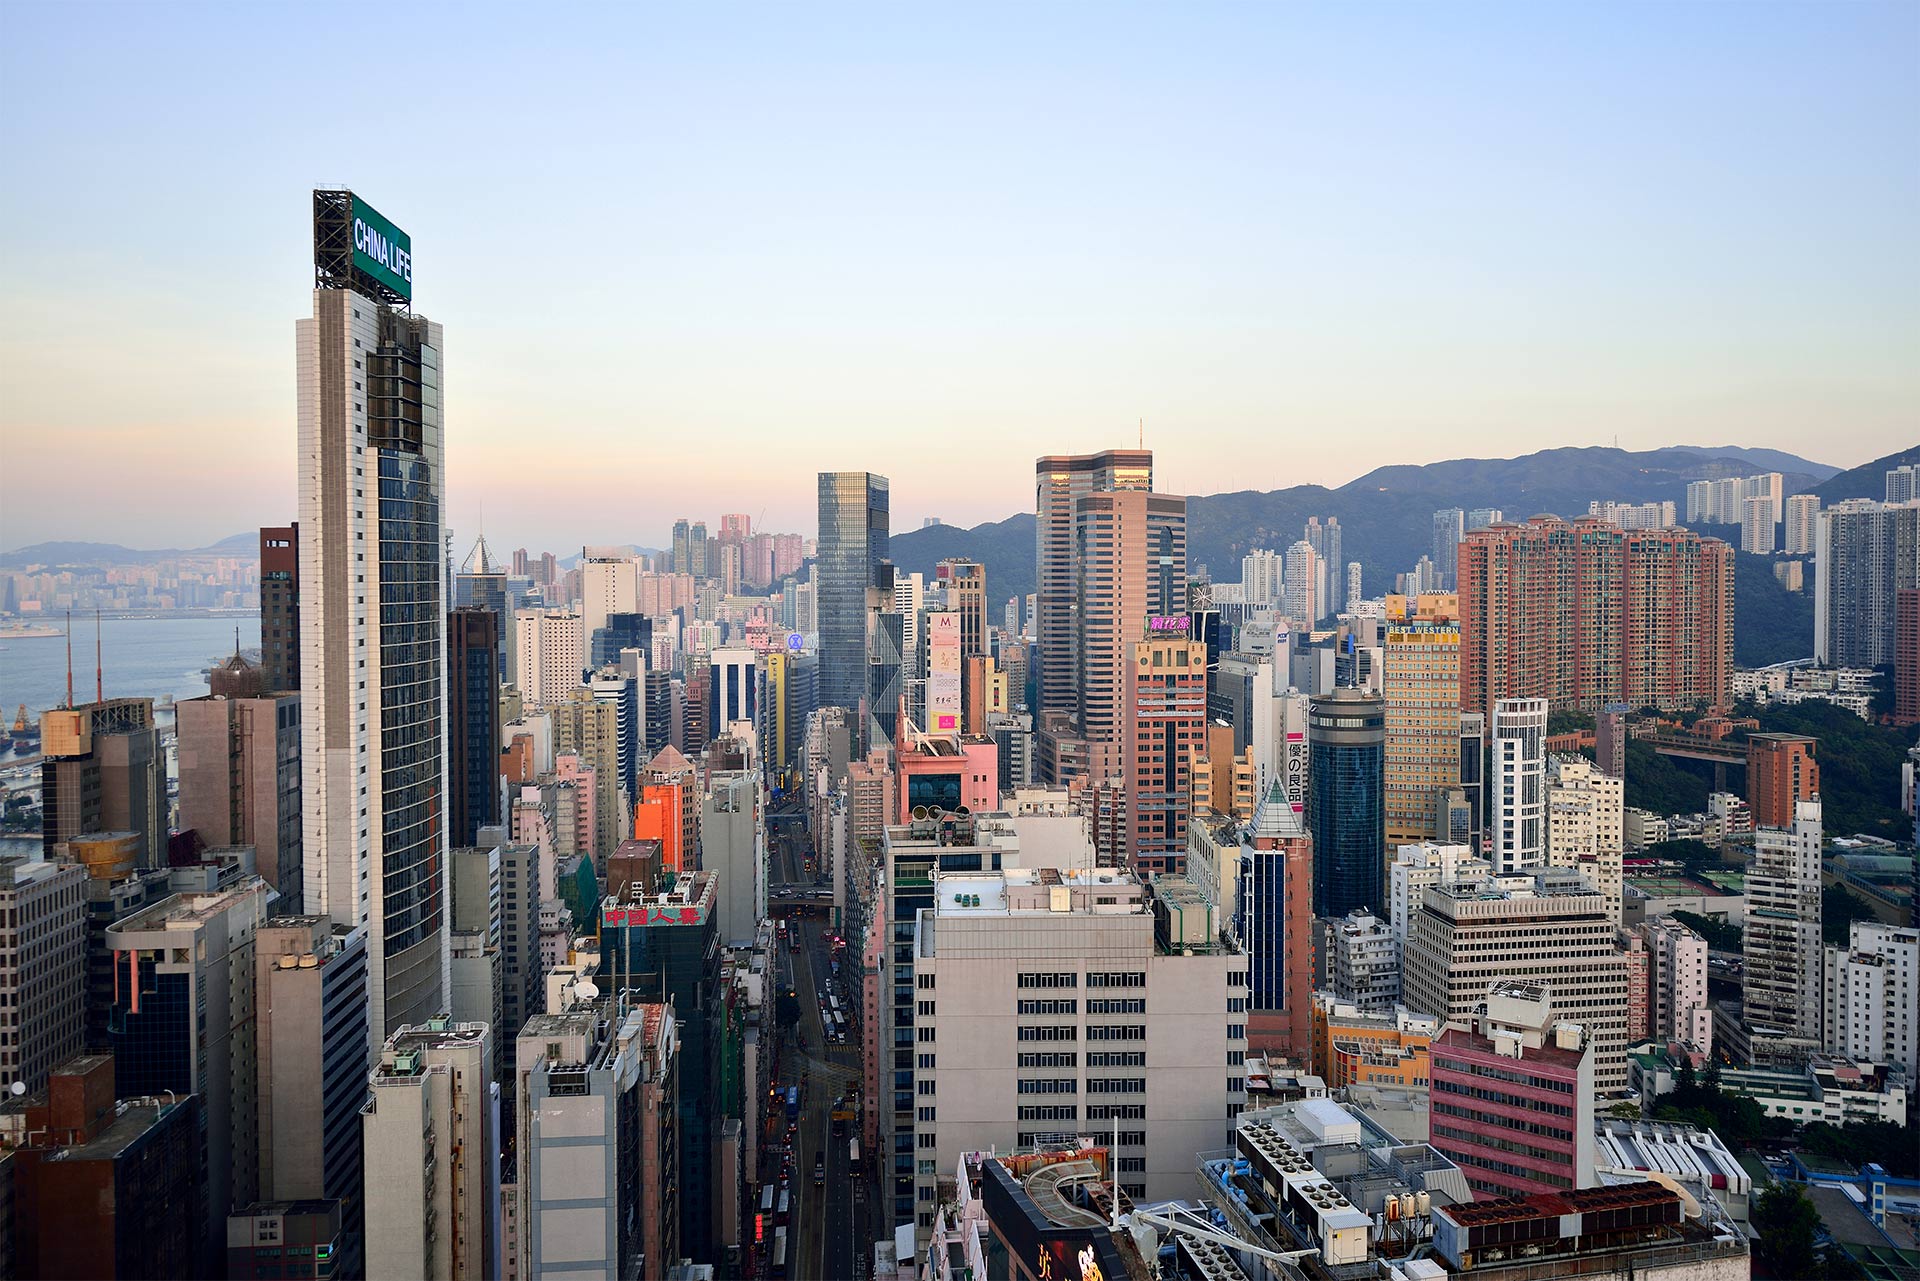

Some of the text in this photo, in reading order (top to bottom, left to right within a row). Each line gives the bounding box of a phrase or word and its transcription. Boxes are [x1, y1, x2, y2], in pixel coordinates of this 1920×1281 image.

[355, 217, 411, 282] CHINA LIFE
[1389, 626, 1459, 634] BEST WESTERN
[1288, 743, 1302, 802] 優の良品
[605, 908, 701, 926] 中國人壽
